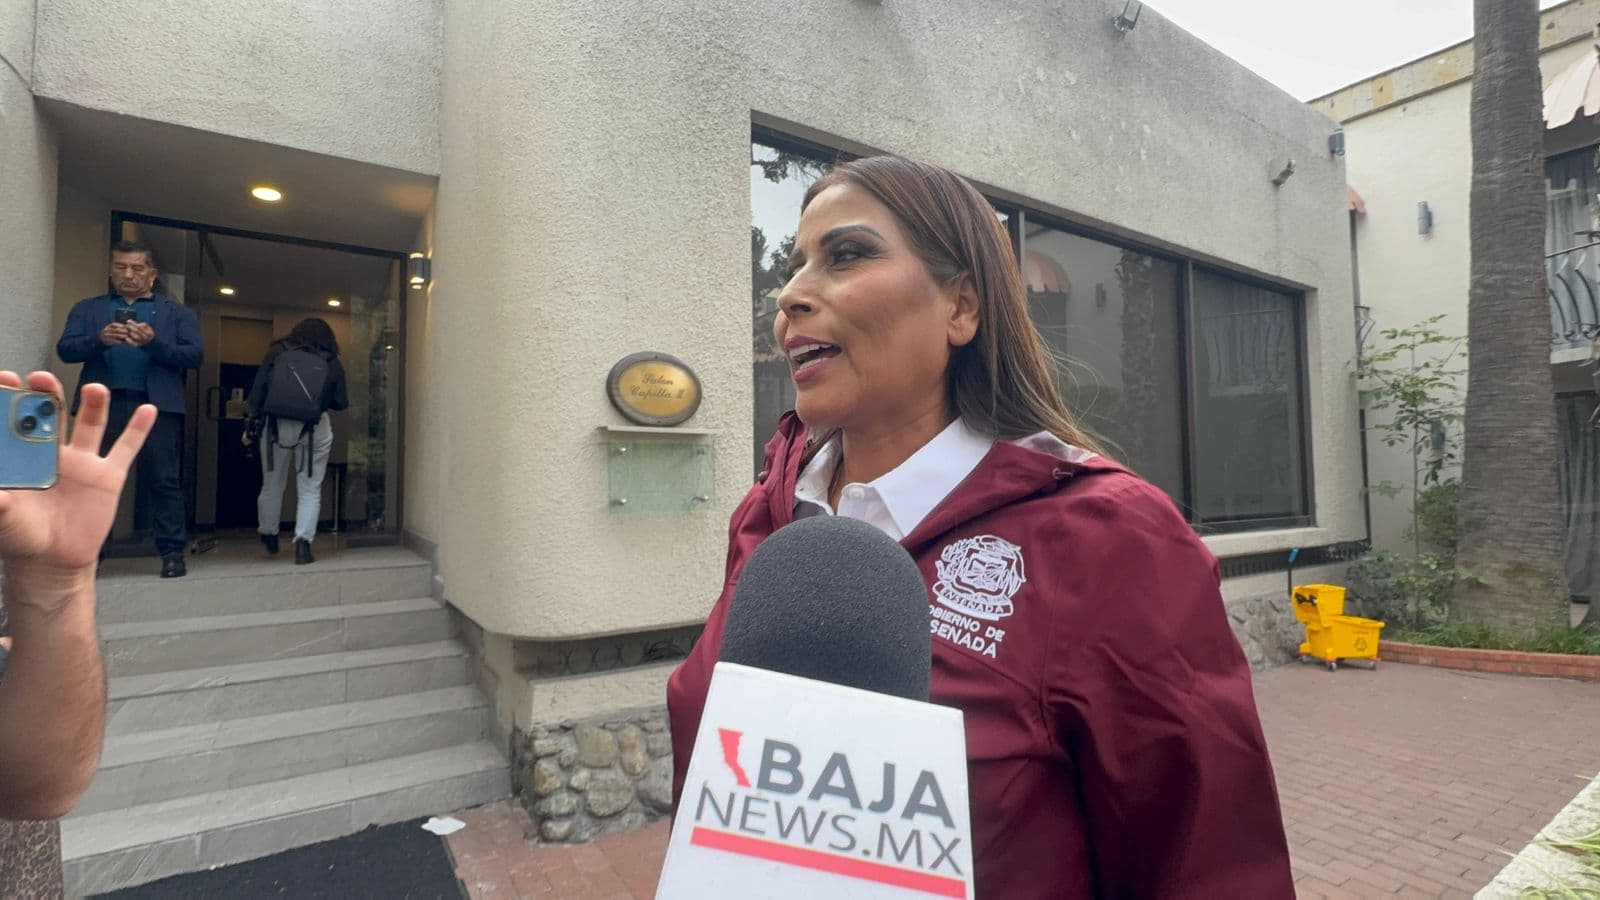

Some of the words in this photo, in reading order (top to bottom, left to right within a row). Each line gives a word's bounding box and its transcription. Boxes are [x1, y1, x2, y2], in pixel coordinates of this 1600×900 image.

[929, 605, 981, 632] OBIERNO
[985, 626, 1005, 642] DE
[931, 619, 996, 658] SENADA
[756, 738, 956, 830] BAJA
[695, 783, 964, 877] NEWS.MX
